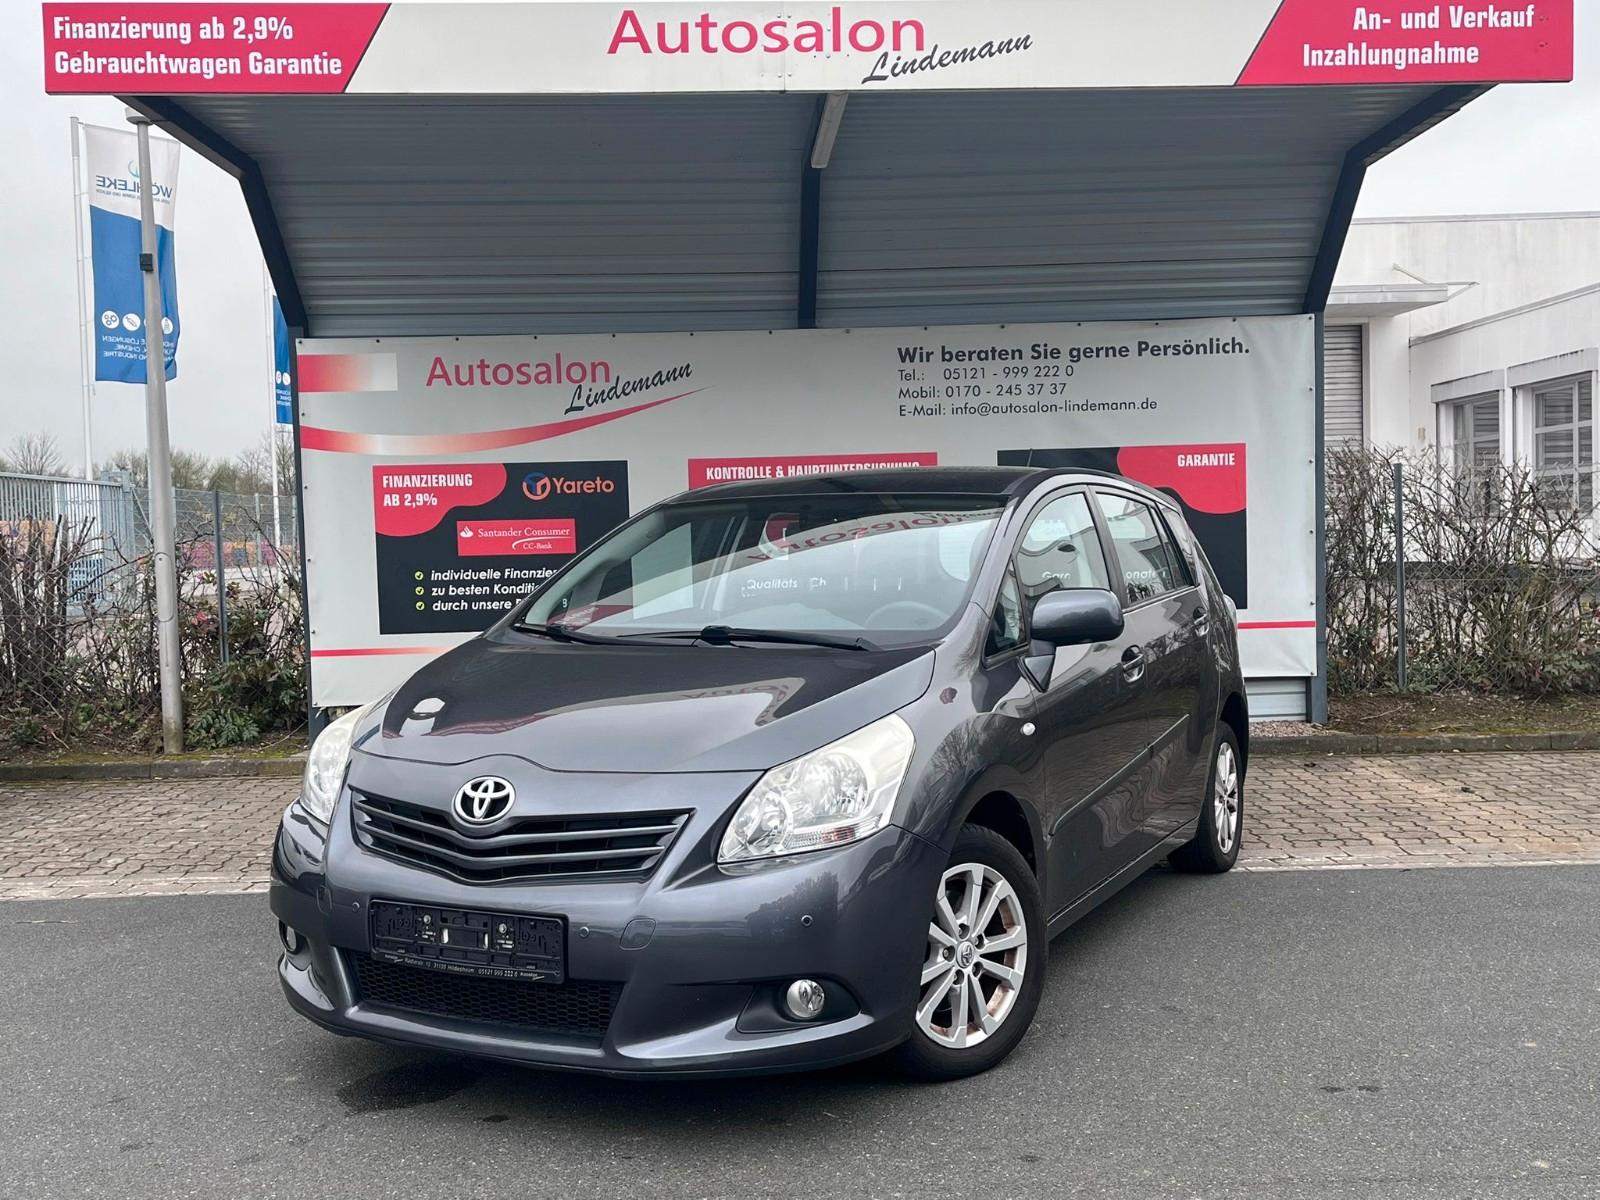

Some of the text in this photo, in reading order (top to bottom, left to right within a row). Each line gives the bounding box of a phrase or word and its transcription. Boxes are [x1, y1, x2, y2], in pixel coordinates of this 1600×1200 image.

[1353, 5, 1534, 30] An- und Verkauf
[53, 16, 293, 44] Finanzierung ab 2,9%
[607, 6, 925, 54] Autosalon
[861, 33, 1033, 84] Lindemann
[1303, 41, 1479, 70] Inzahlungnahme
[55, 51, 342, 79] Gebrauchtwagen Garantie
[898, 337, 1250, 363] Wir beraten Sie gerne Persönlich.
[426, 353, 610, 387] Autosalon
[898, 369, 925, 381] Tel.:
[943, 367, 986, 380] 05121
[1002, 366, 1029, 379] 999
[1033, 365, 1060, 377] 222
[1065, 365, 1074, 377] 0
[564, 363, 693, 415] Lindemann
[899, 386, 941, 399] Mobil:
[945, 385, 981, 398] 0170
[996, 384, 1022, 396] 245
[1027, 383, 1044, 396] 37
[1050, 383, 1067, 395] 37
[899, 398, 1158, 417] E-Mail: info@autosalon-lindemann.de
[1177, 452, 1235, 467] GARANTIE
[382, 473, 473, 488] FINANZIERUNG
[706, 466, 771, 480] KONTROLLE
[776, 465, 785, 478] &
[553, 477, 615, 494] Yareto
[383, 493, 438, 508] AB 2,9%
[478, 526, 570, 538] Santander Consumer
[523, 542, 552, 550] CC-Bank
[431, 568, 502, 581] individuelle
[431, 587, 446, 596] zu
[448, 584, 490, 596] besten
[432, 599, 468, 611] durch
[472, 600, 512, 610] unsere
